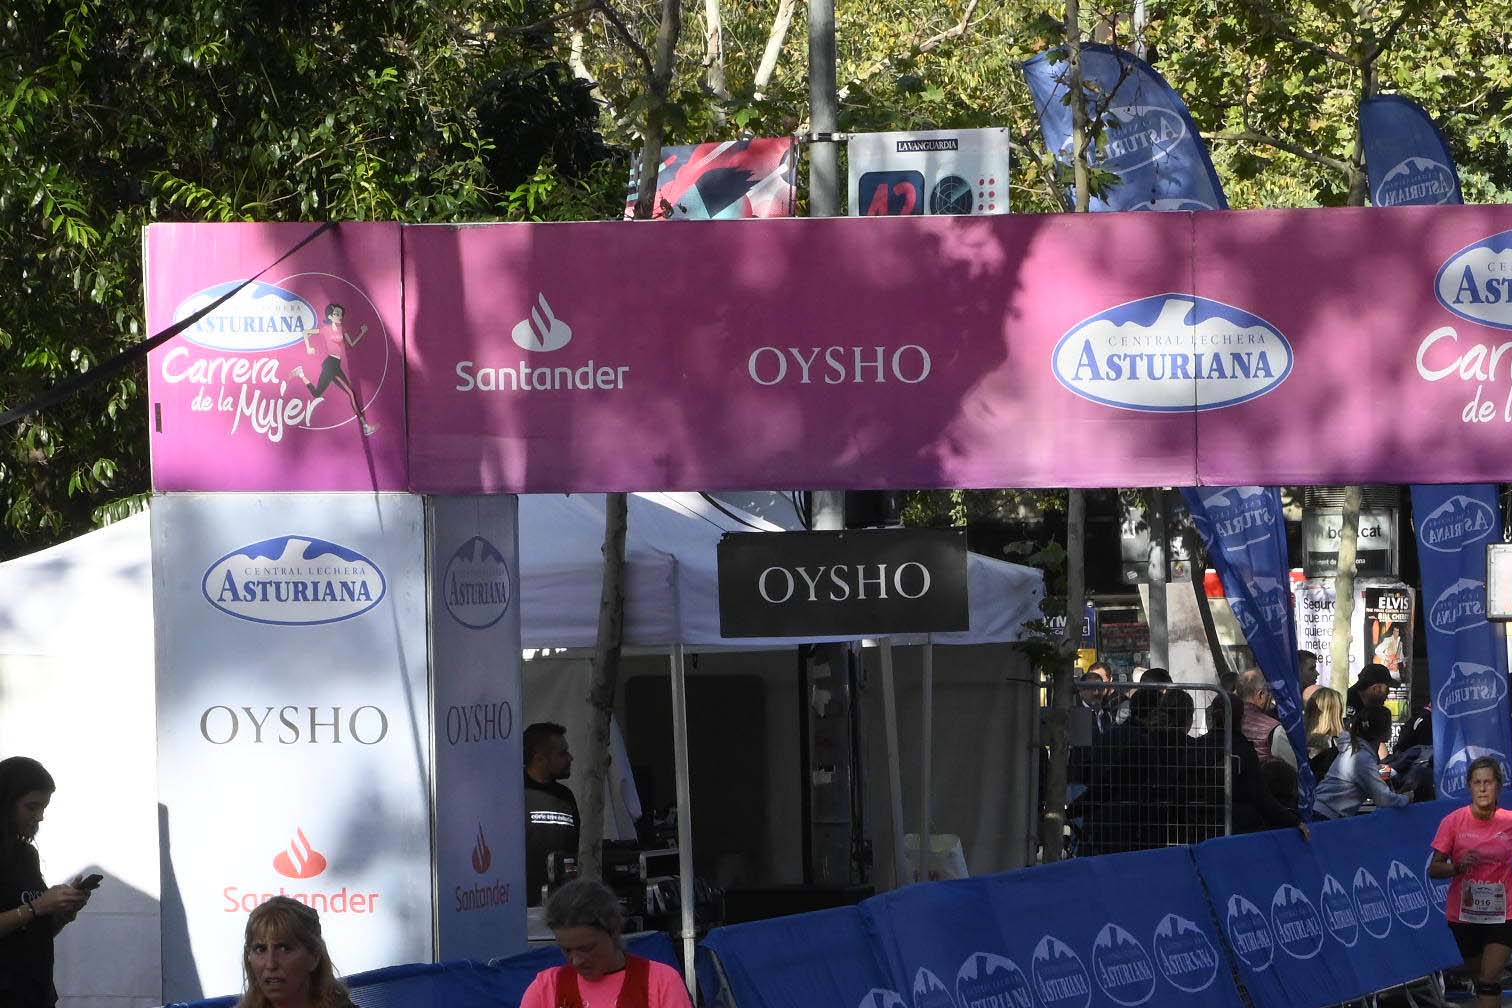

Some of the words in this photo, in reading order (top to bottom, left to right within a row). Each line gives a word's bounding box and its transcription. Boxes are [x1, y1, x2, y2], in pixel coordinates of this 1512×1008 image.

[907, 140, 957, 151] VANGUARDIA
[1108, 335, 1184, 347] CENTRAL
[1191, 333, 1266, 345] LECHERA
[161, 346, 280, 384] Carrera
[456, 360, 630, 392] Santander
[748, 344, 932, 385] OYSHO
[1071, 338, 1275, 382] ASTURIANA
[191, 383, 214, 411] de
[217, 387, 234, 412] la
[230, 380, 325, 442] Mujer
[1461, 385, 1497, 423] de
[217, 569, 373, 603] ASTURIANA
[244, 567, 303, 576] CENTRAL
[308, 566, 366, 576] LECHERA
[449, 570, 506, 606] ASTURIANA
[758, 561, 931, 604] OYSHO
[1378, 597, 1409, 609] ELVIS
[200, 704, 389, 746] OYSHO
[446, 700, 513, 747] OYSHO
[455, 880, 510, 913] Santander
